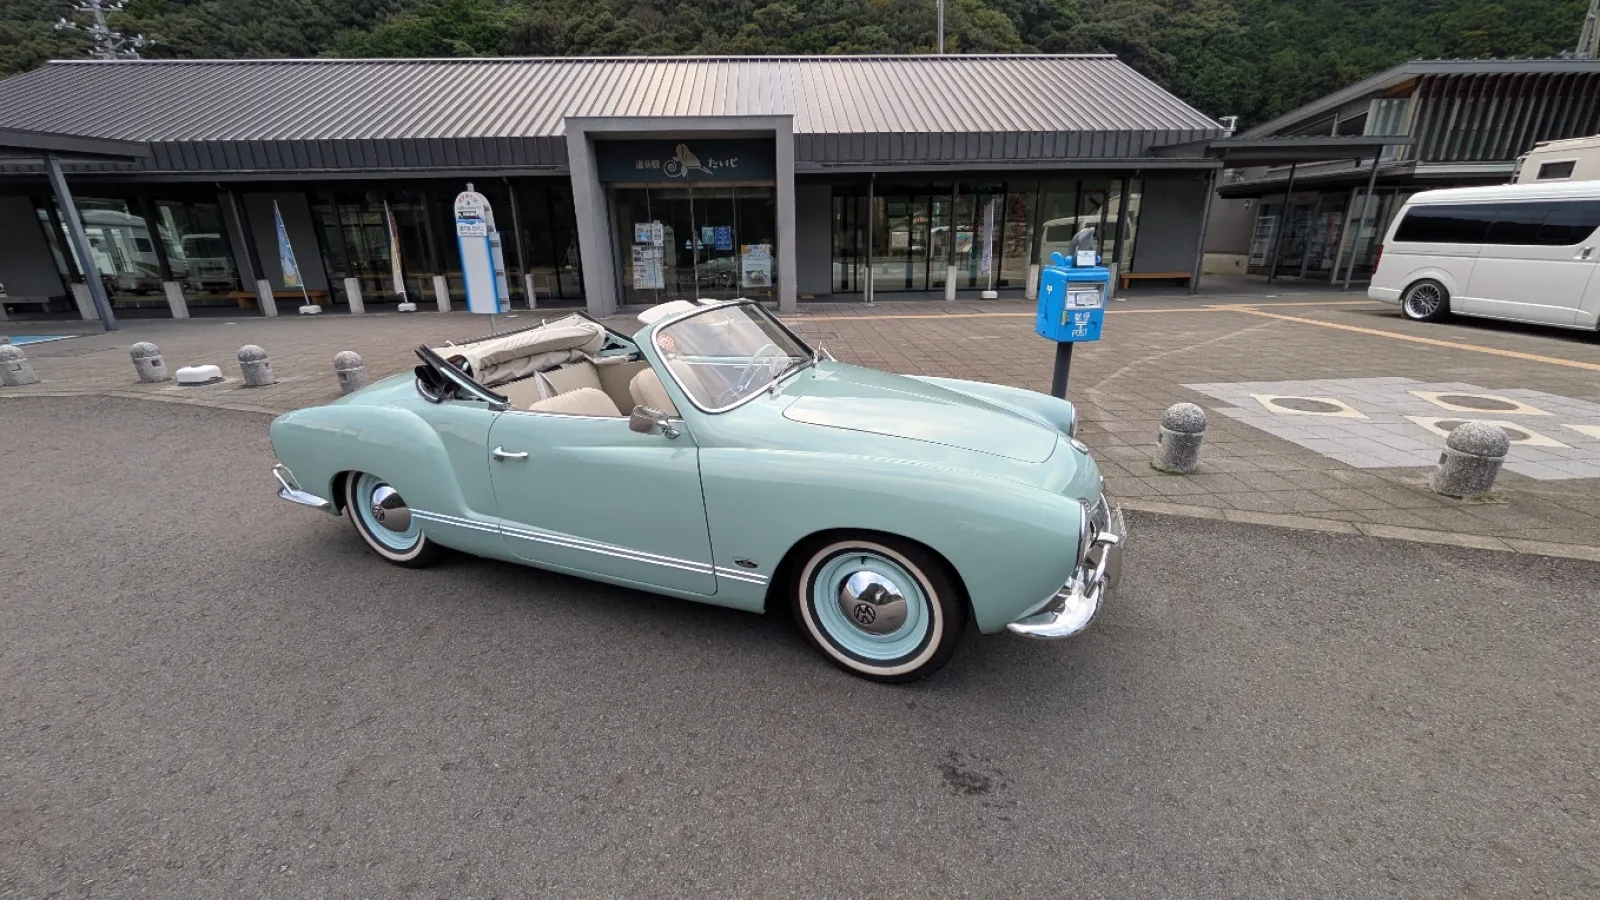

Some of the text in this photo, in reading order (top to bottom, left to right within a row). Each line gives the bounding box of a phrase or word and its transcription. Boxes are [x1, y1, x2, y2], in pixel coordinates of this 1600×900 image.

[708, 157, 739, 169] たいじ
[1071, 328, 1088, 338] POST
